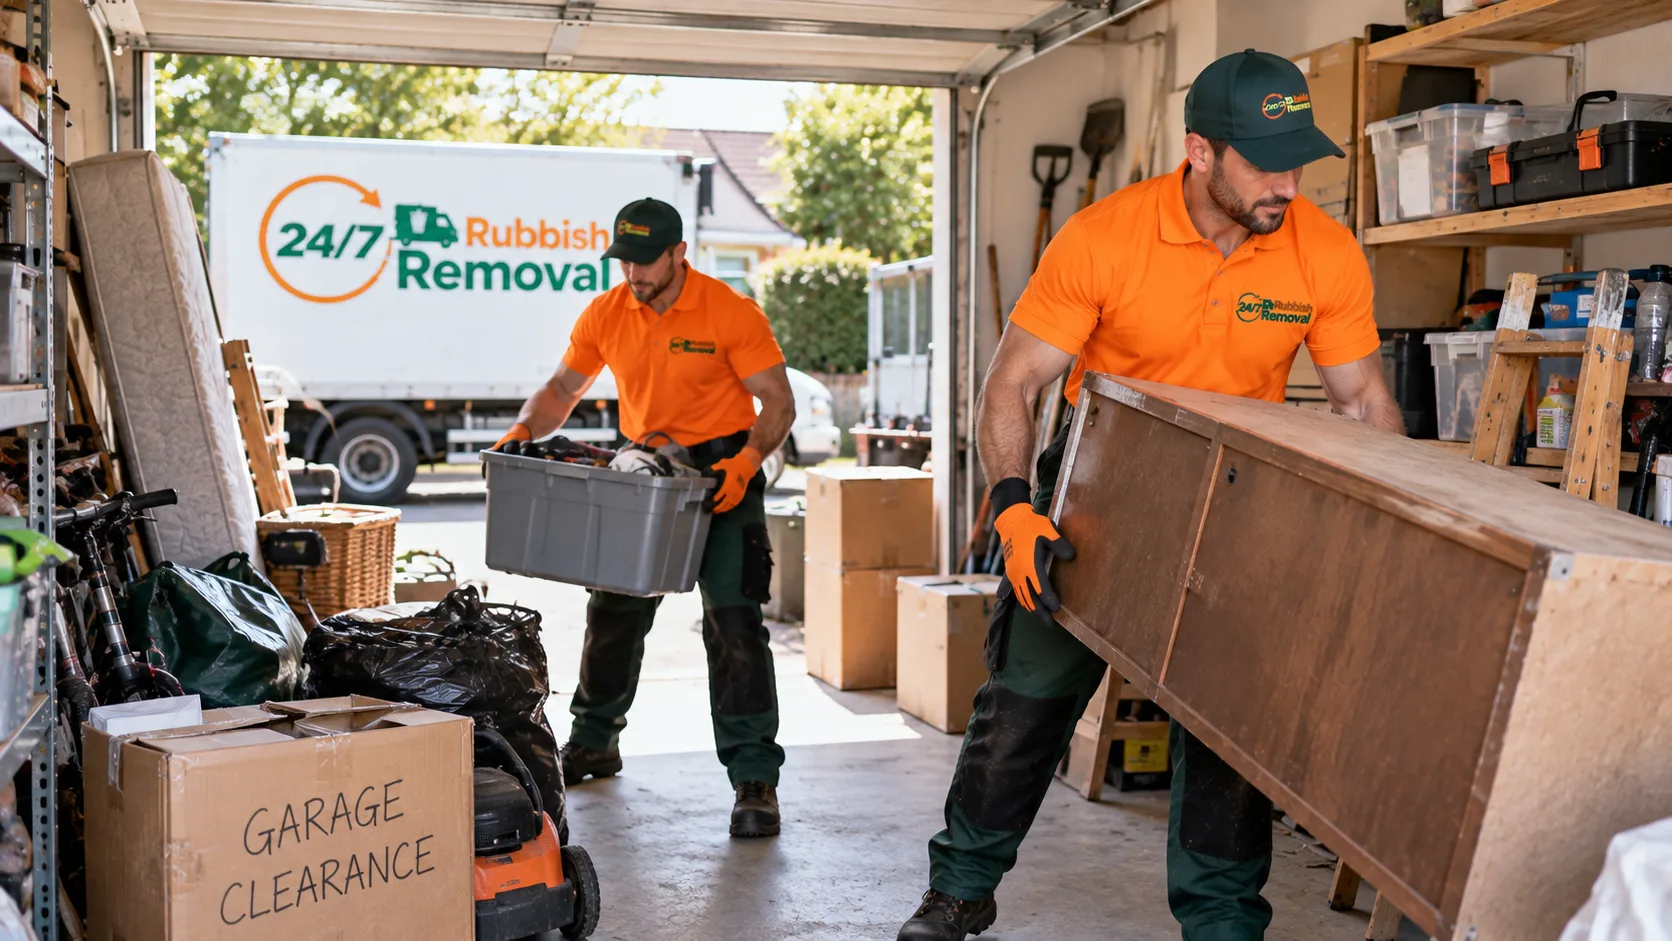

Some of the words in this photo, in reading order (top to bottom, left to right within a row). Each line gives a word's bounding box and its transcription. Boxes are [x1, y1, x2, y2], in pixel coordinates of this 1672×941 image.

[277, 223, 384, 259] 24/7
[466, 217, 609, 250] Rubbish
[397, 250, 609, 291] Removal
[1239, 301, 1262, 313] 24/7
[1261, 310, 1311, 324] Removal
[1274, 300, 1313, 313] Rubbish
[243, 779, 405, 856] GARAGE
[219, 834, 436, 926] CLEARANCE
